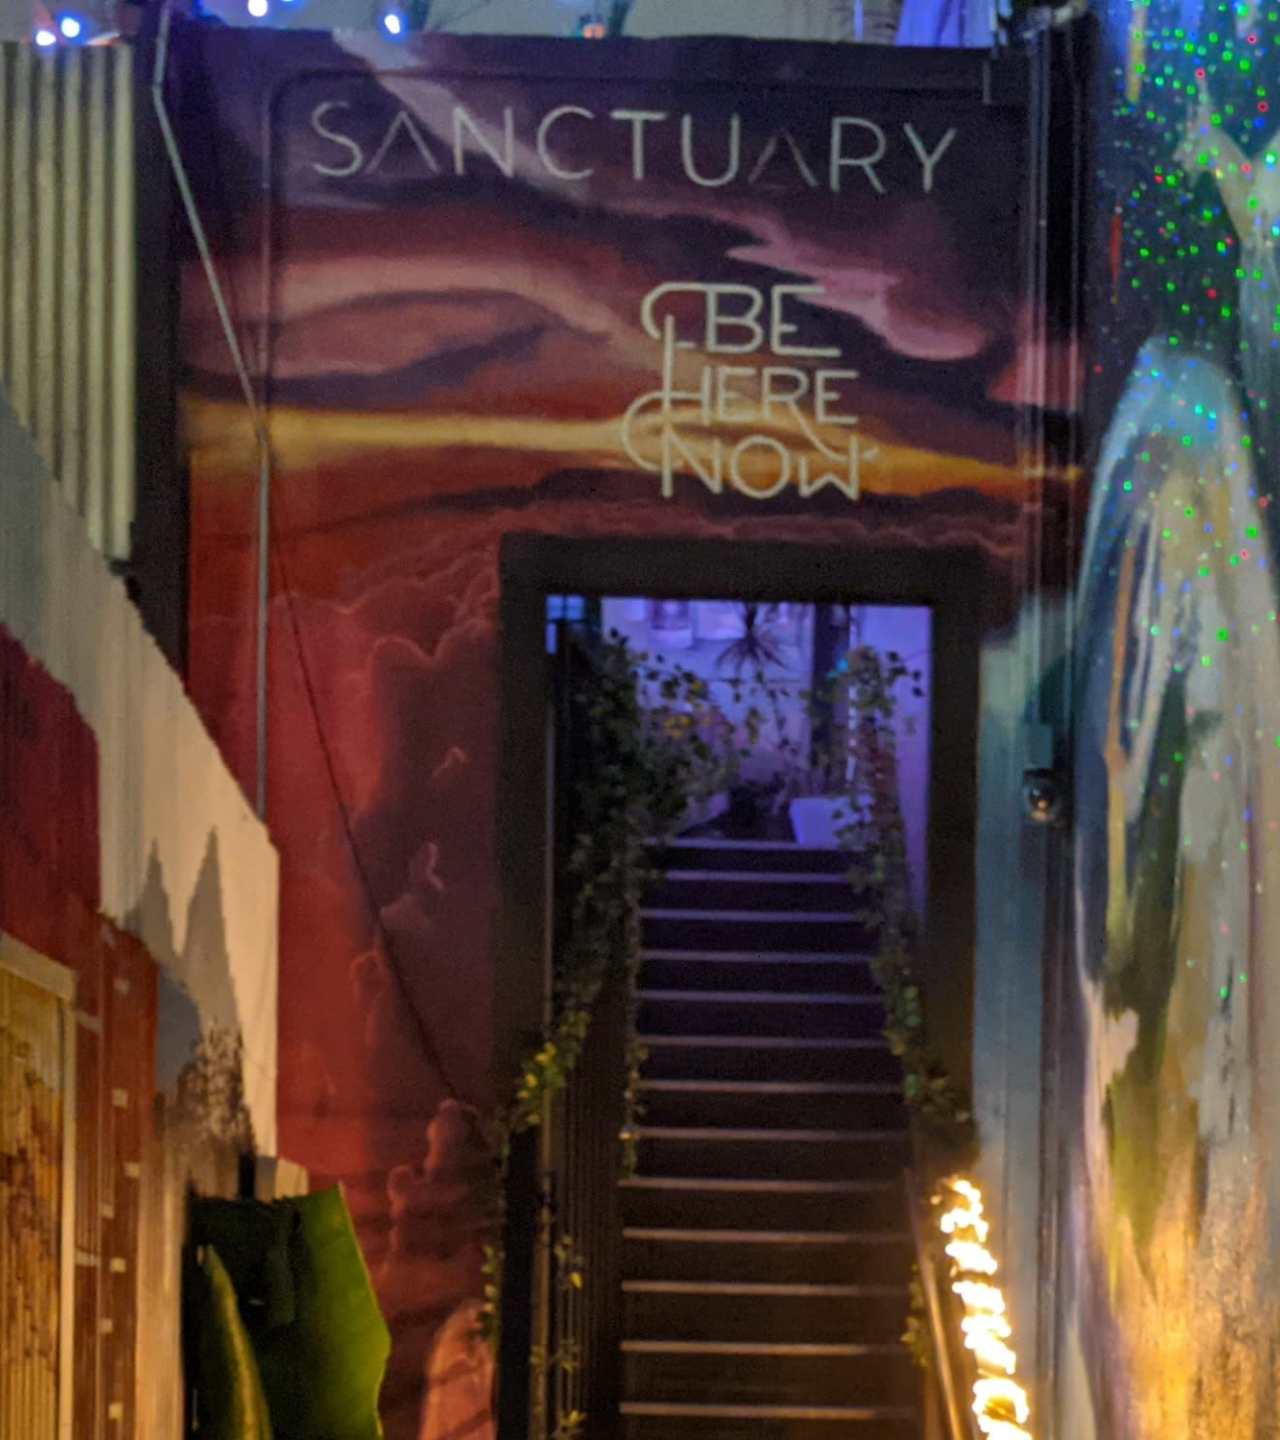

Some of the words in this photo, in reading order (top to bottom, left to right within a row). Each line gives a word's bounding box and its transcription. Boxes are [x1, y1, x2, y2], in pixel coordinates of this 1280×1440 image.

[311, 101, 958, 194] SANCTUARY
[640, 281, 842, 358] BE
[635, 338, 865, 434] HERE
[660, 424, 861, 500] NOW
